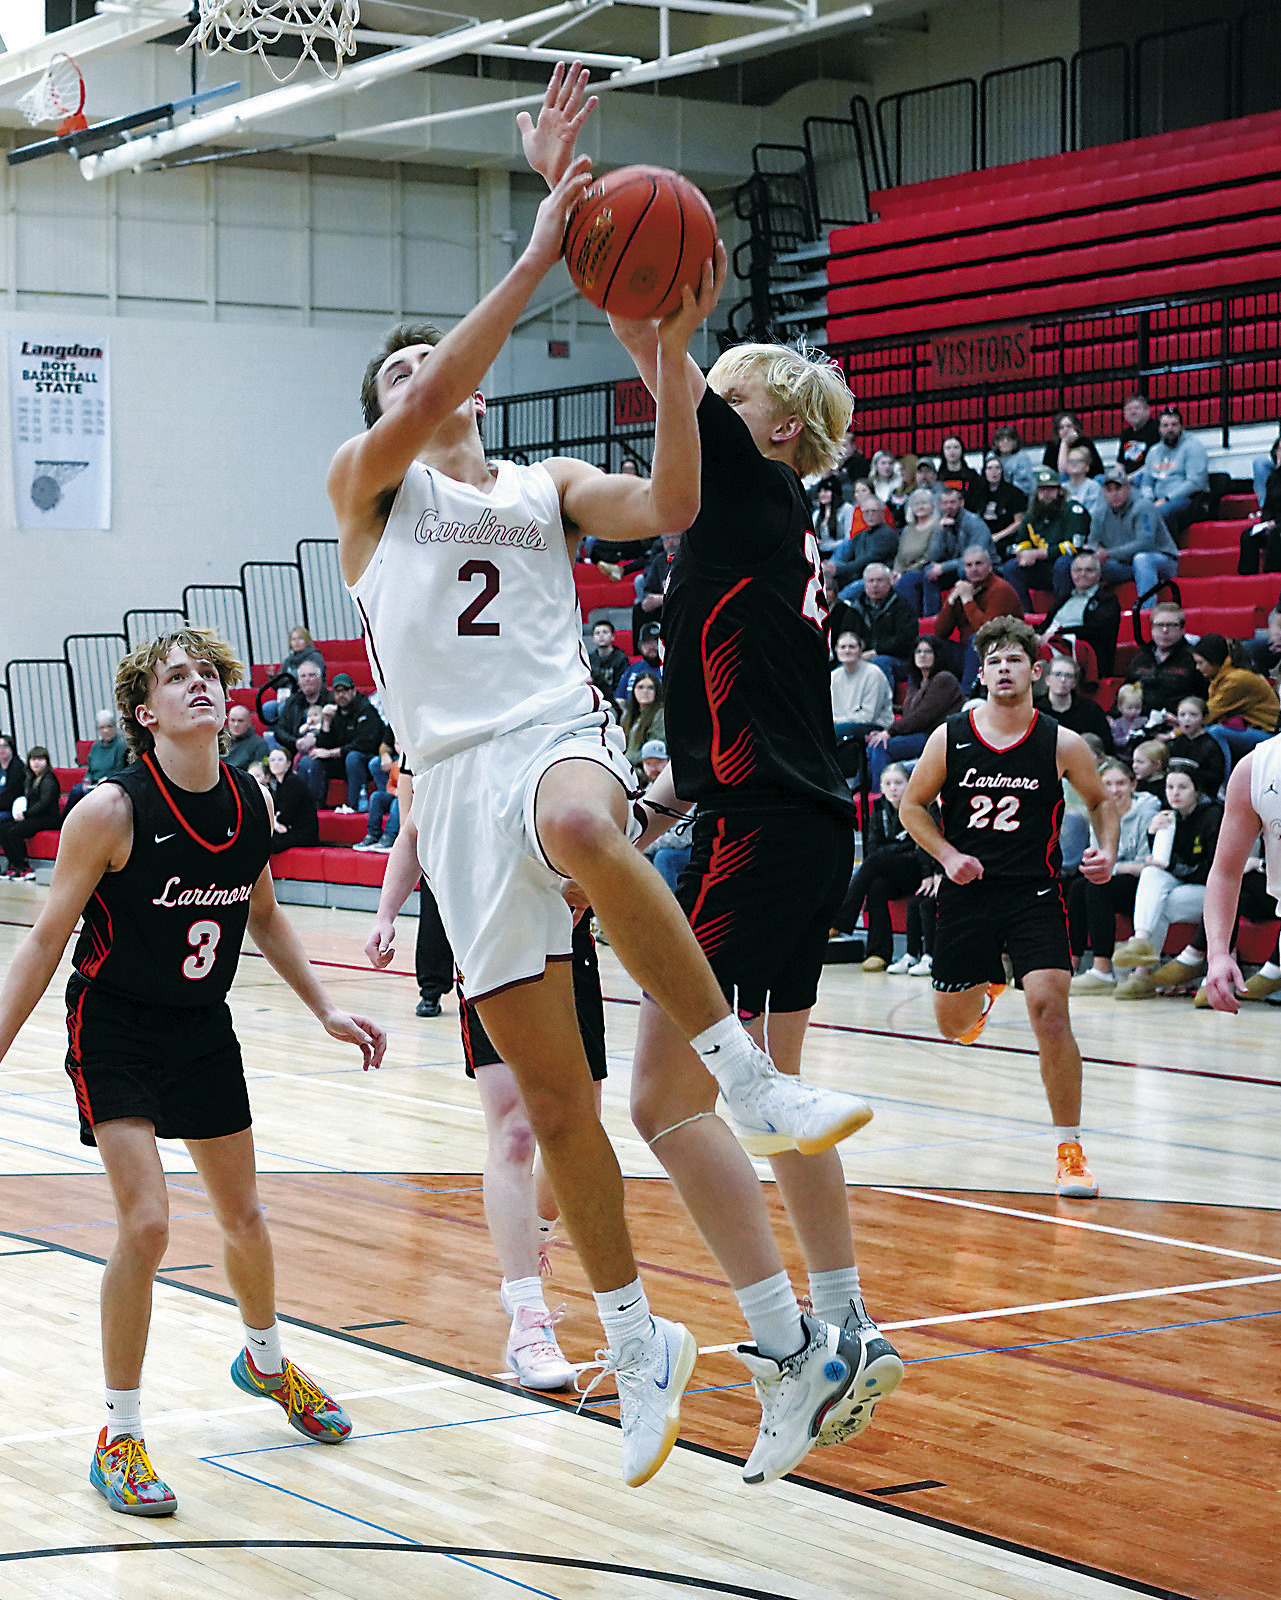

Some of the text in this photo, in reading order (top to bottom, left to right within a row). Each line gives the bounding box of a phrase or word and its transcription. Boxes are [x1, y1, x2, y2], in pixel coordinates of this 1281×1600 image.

[21, 341, 103, 360] Langdon
[936, 333, 1026, 376] VISITORS
[22, 370, 99, 383] BASKETBALL
[41, 361, 77, 371] BOYS
[35, 382, 83, 394] STATE
[414, 507, 548, 551] Cardinals
[457, 558, 501, 637] 2
[958, 767, 1040, 790] Larimore
[966, 794, 1021, 832] 22
[181, 918, 222, 981] 3
